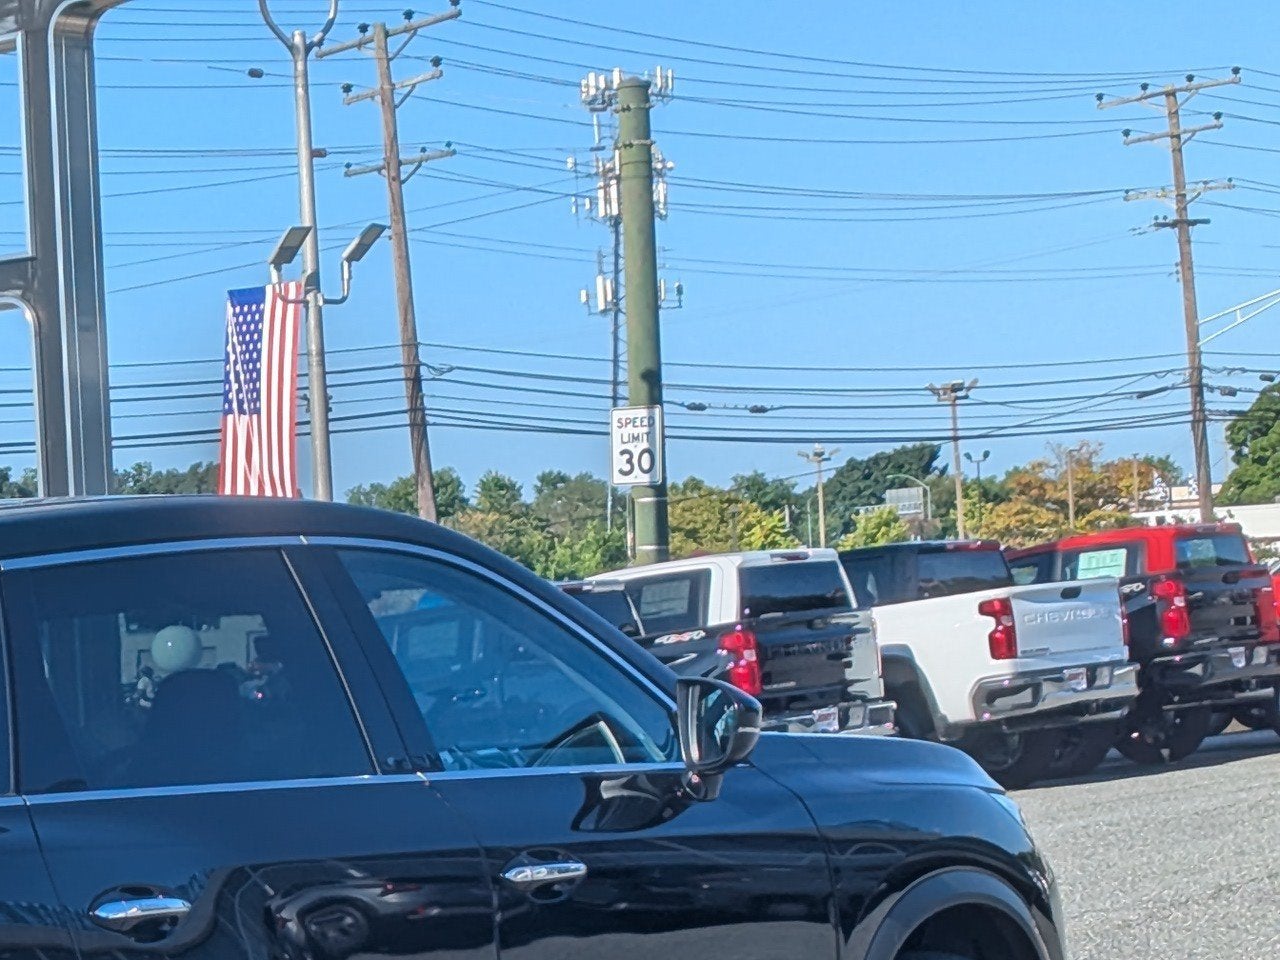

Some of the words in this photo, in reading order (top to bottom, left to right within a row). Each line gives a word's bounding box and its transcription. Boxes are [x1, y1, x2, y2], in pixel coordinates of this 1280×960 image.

[617, 415, 655, 429] SPEED
[621, 431, 651, 444] LIMIT
[618, 447, 655, 476] 30
[1023, 606, 1112, 626] CHEVRO
